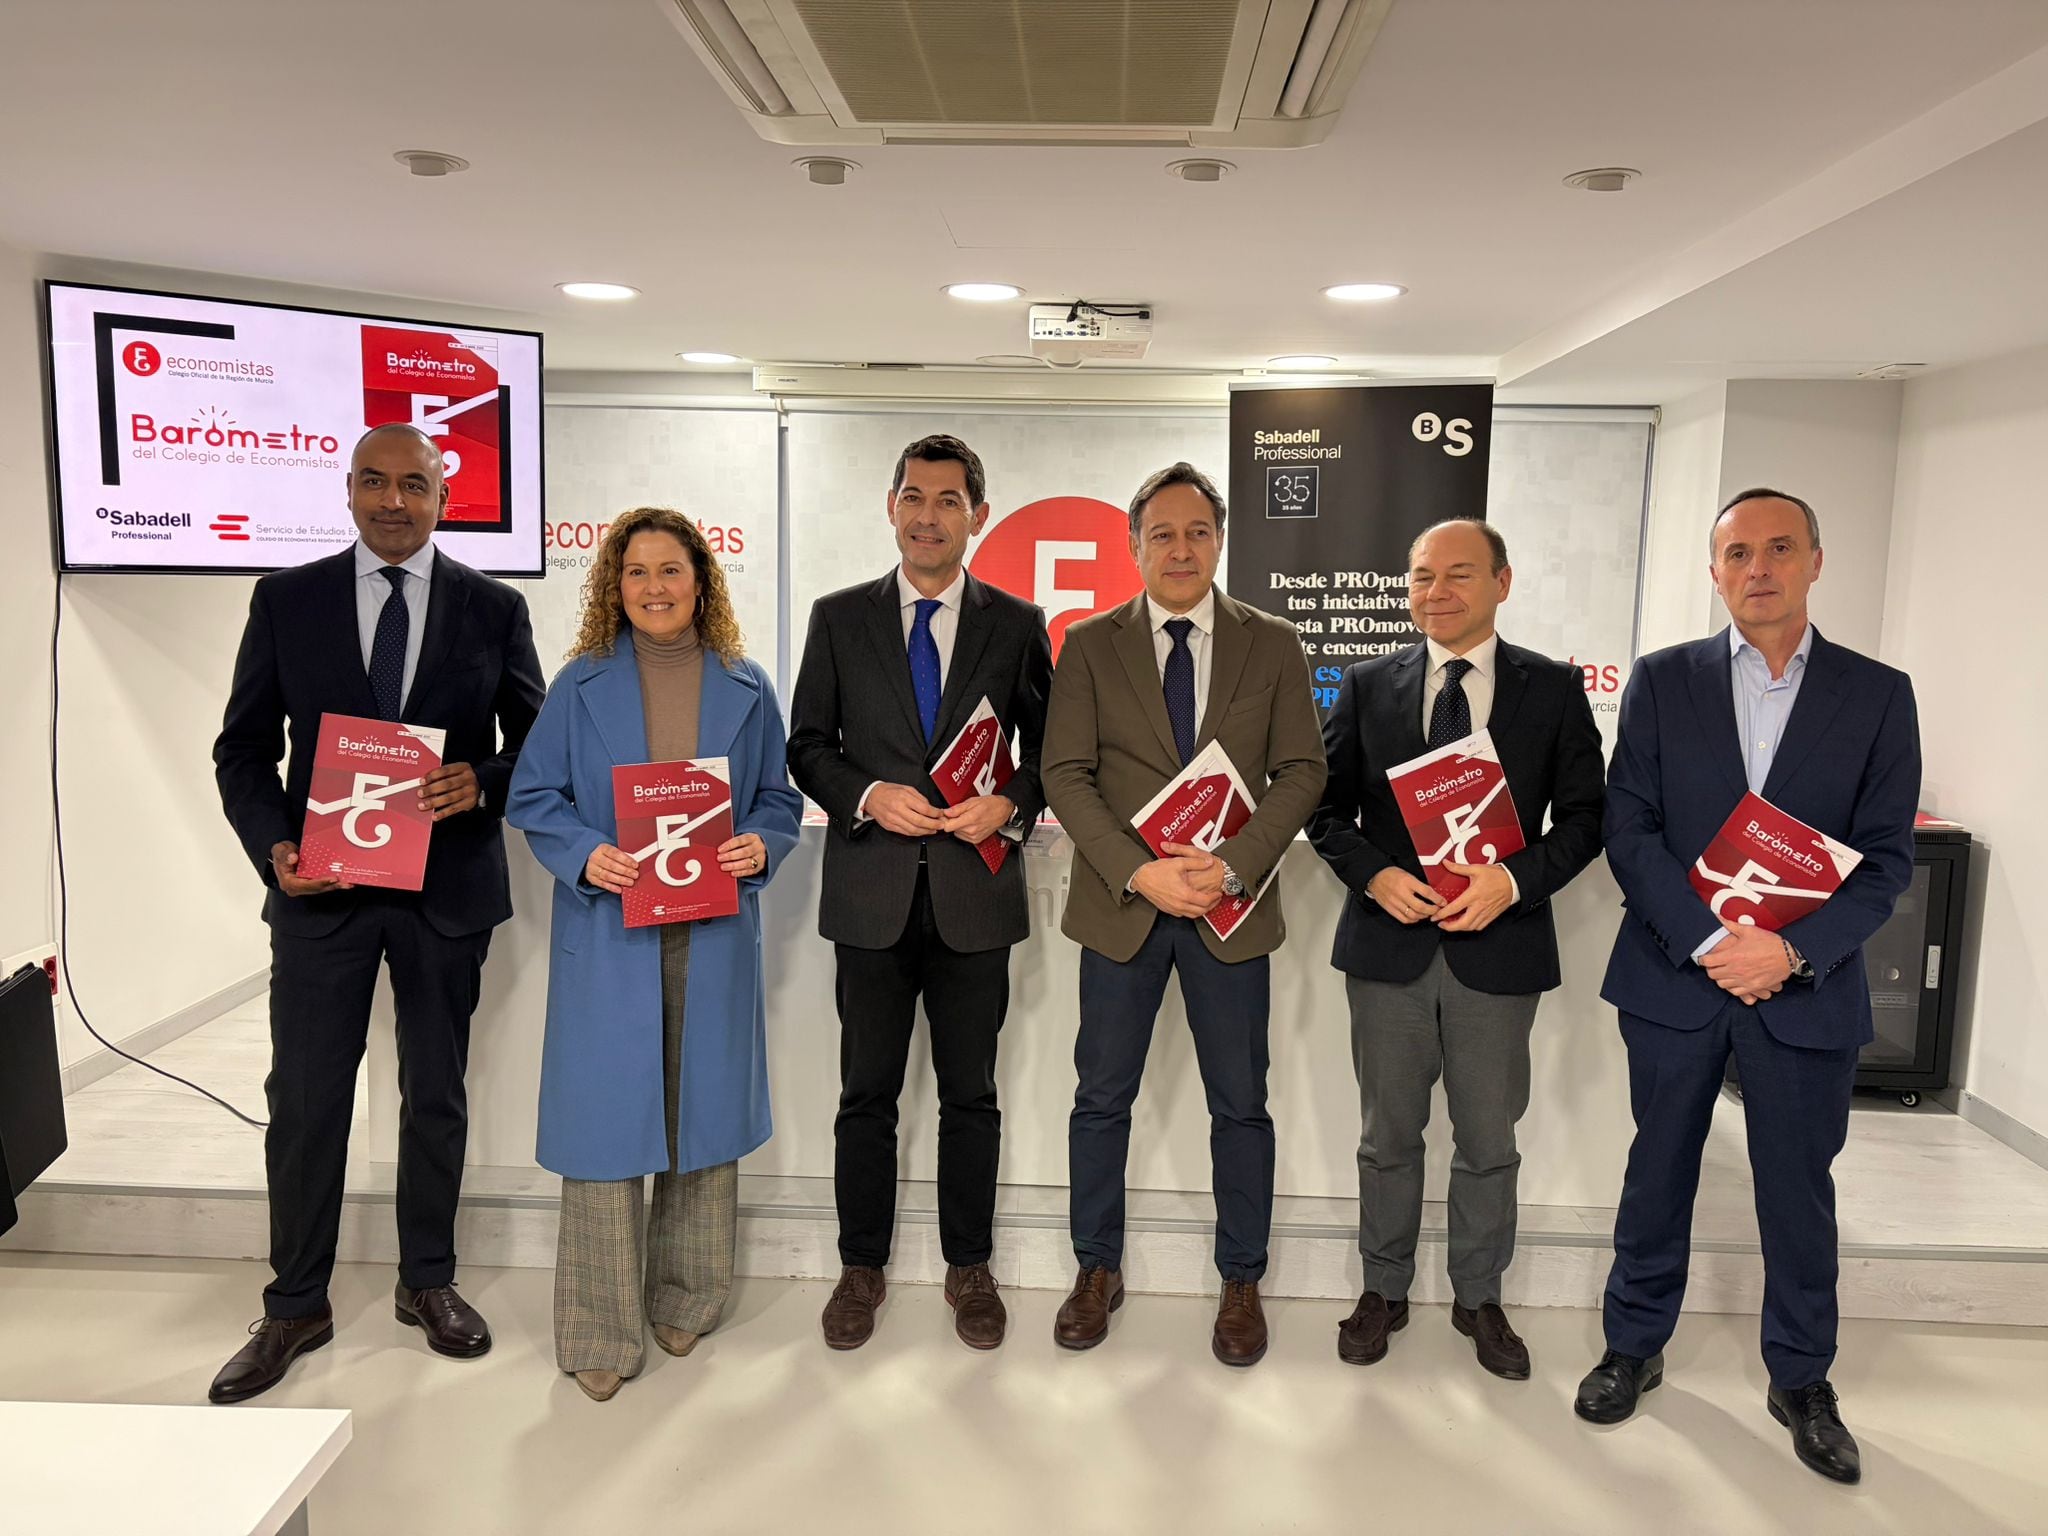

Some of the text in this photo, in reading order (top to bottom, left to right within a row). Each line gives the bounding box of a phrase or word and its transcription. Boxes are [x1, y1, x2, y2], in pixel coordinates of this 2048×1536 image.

[167, 356, 274, 377] economistas
[168, 370, 189, 378] Colegio
[190, 371, 209, 379] Oficial
[387, 367, 476, 381] del Colegio de Economistas
[1254, 429, 1321, 445] Sabadell
[132, 446, 340, 469] del Colegio de Economistas
[1254, 445, 1342, 461] Professional
[1275, 475, 1310, 502] 35
[110, 510, 191, 528] Sabadell
[111, 531, 172, 540] Professional
[256, 524, 293, 534] Servicio
[295, 525, 307, 535] de
[310, 526, 346, 536] Estudios
[1270, 571, 1410, 592] Desde PROpul
[1288, 593, 1411, 610] tus iniciativa
[1296, 616, 1423, 634] sta PROmov
